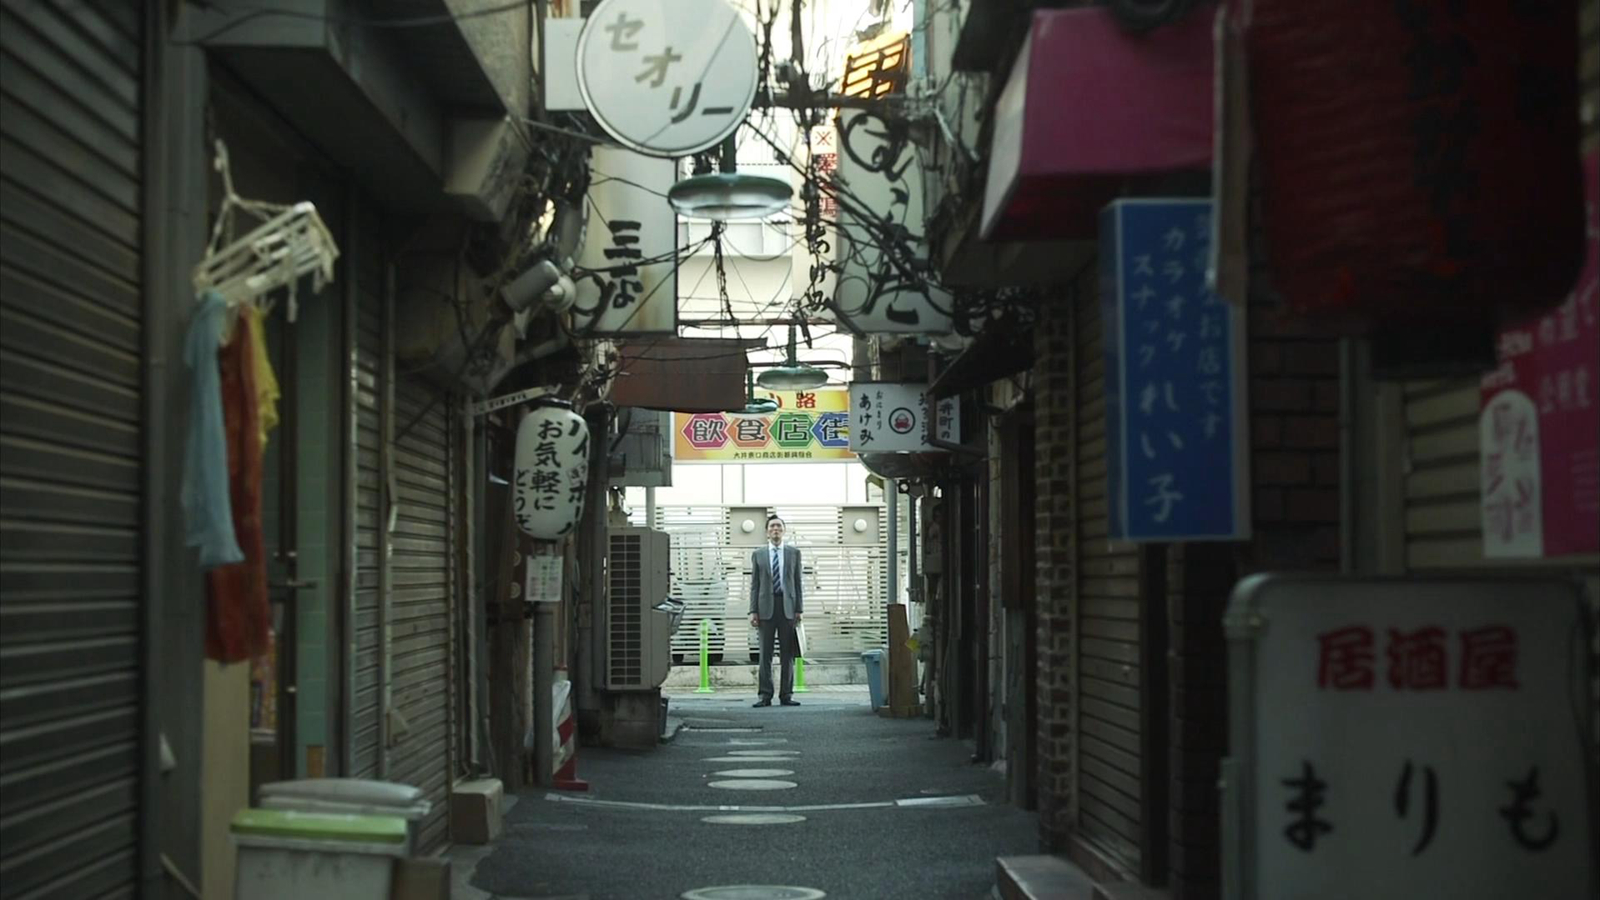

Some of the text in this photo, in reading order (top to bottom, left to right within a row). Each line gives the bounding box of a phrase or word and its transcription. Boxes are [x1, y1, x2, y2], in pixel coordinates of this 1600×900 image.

[604, 12, 734, 124] セオリー
[1131, 253, 1157, 368] スナック
[1161, 226, 1187, 352] カラオケ
[529, 419, 563, 511] お気軽に
[691, 417, 849, 442] 飲食店街
[859, 392, 874, 447] あけみ
[1137, 381, 1186, 524] れい子
[514, 468, 533, 532] どうぞ
[1316, 624, 1521, 693] 居酒屋
[1281, 758, 1560, 858] まりも
